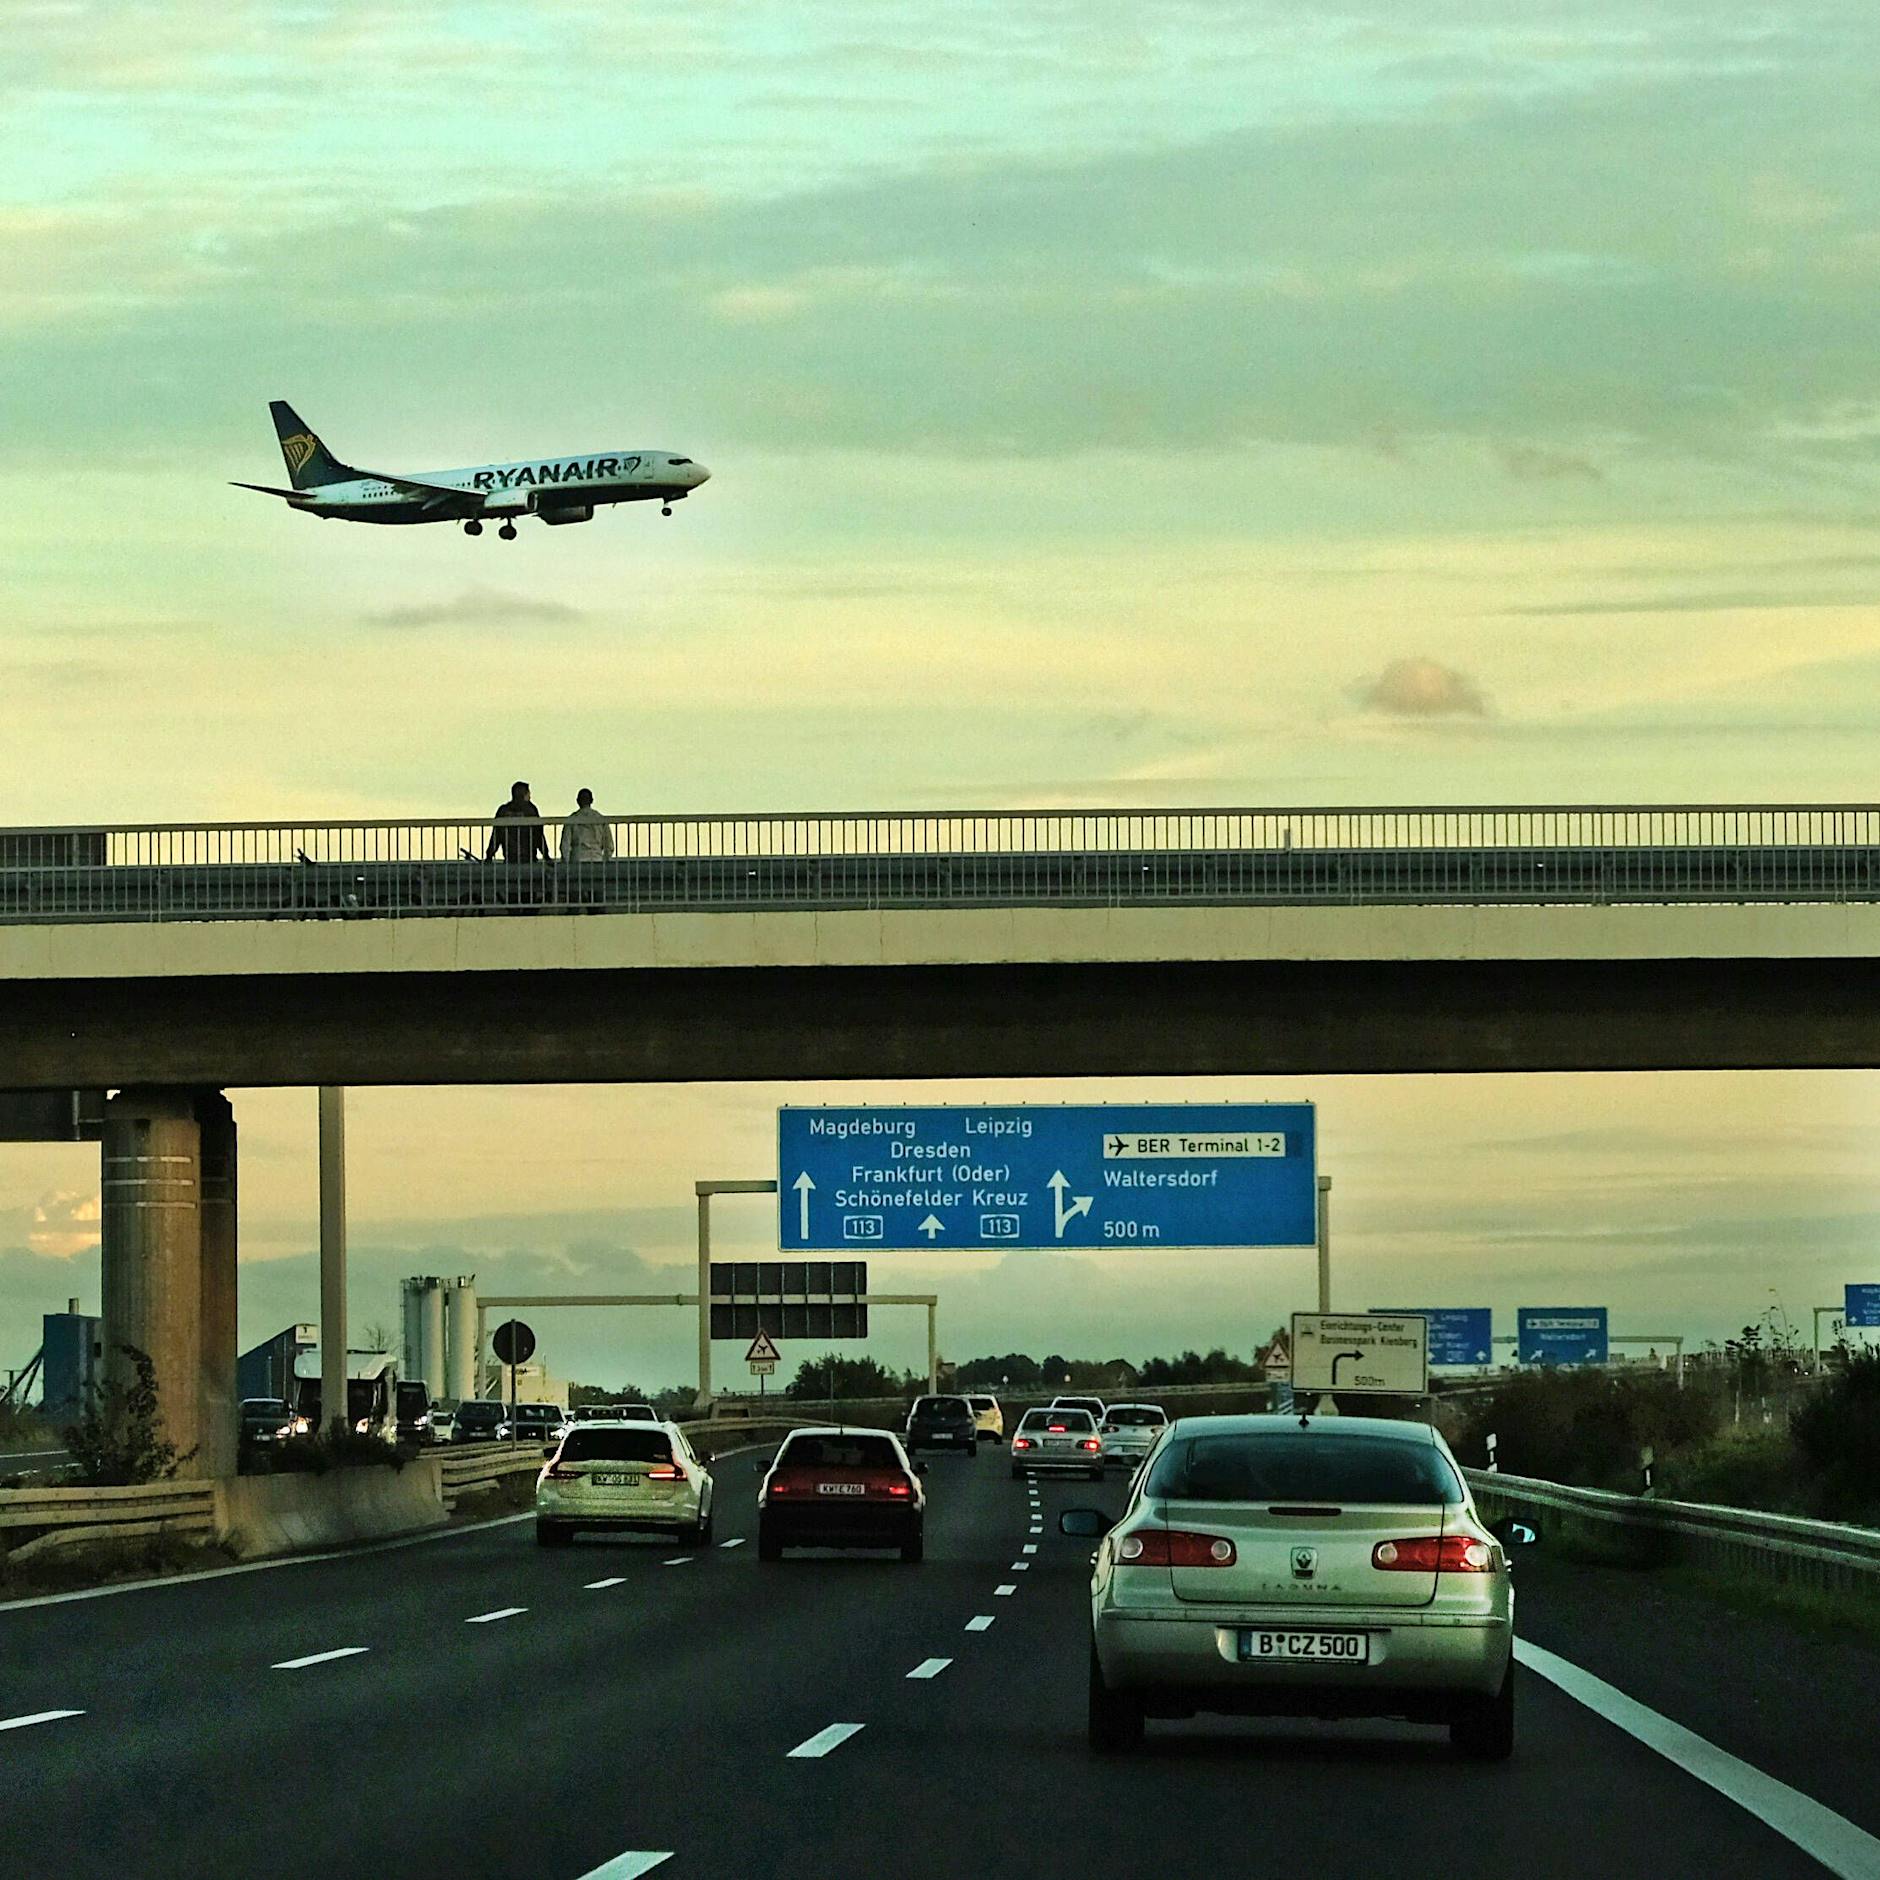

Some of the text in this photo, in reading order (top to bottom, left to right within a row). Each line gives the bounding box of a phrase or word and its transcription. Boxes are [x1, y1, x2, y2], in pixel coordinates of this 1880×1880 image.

[474, 458, 618, 490] RYANAIR
[809, 1118, 916, 1138] Magdeburg
[964, 1117, 1033, 1138] Leipzig
[890, 1141, 971, 1159] Dresden
[1137, 1137, 1281, 1154] BER Terminal 1-2
[852, 1165, 1010, 1184] Frankfurt (Oder)
[1103, 1169, 1218, 1188] Waltersdorf
[835, 1188, 1029, 1208] Schönefelder Kreuz
[851, 1220, 876, 1236] 113
[987, 1220, 1013, 1236] 113
[1104, 1221, 1160, 1239] 500 m
[1260, 1634, 1359, 1657] B CZ 500
